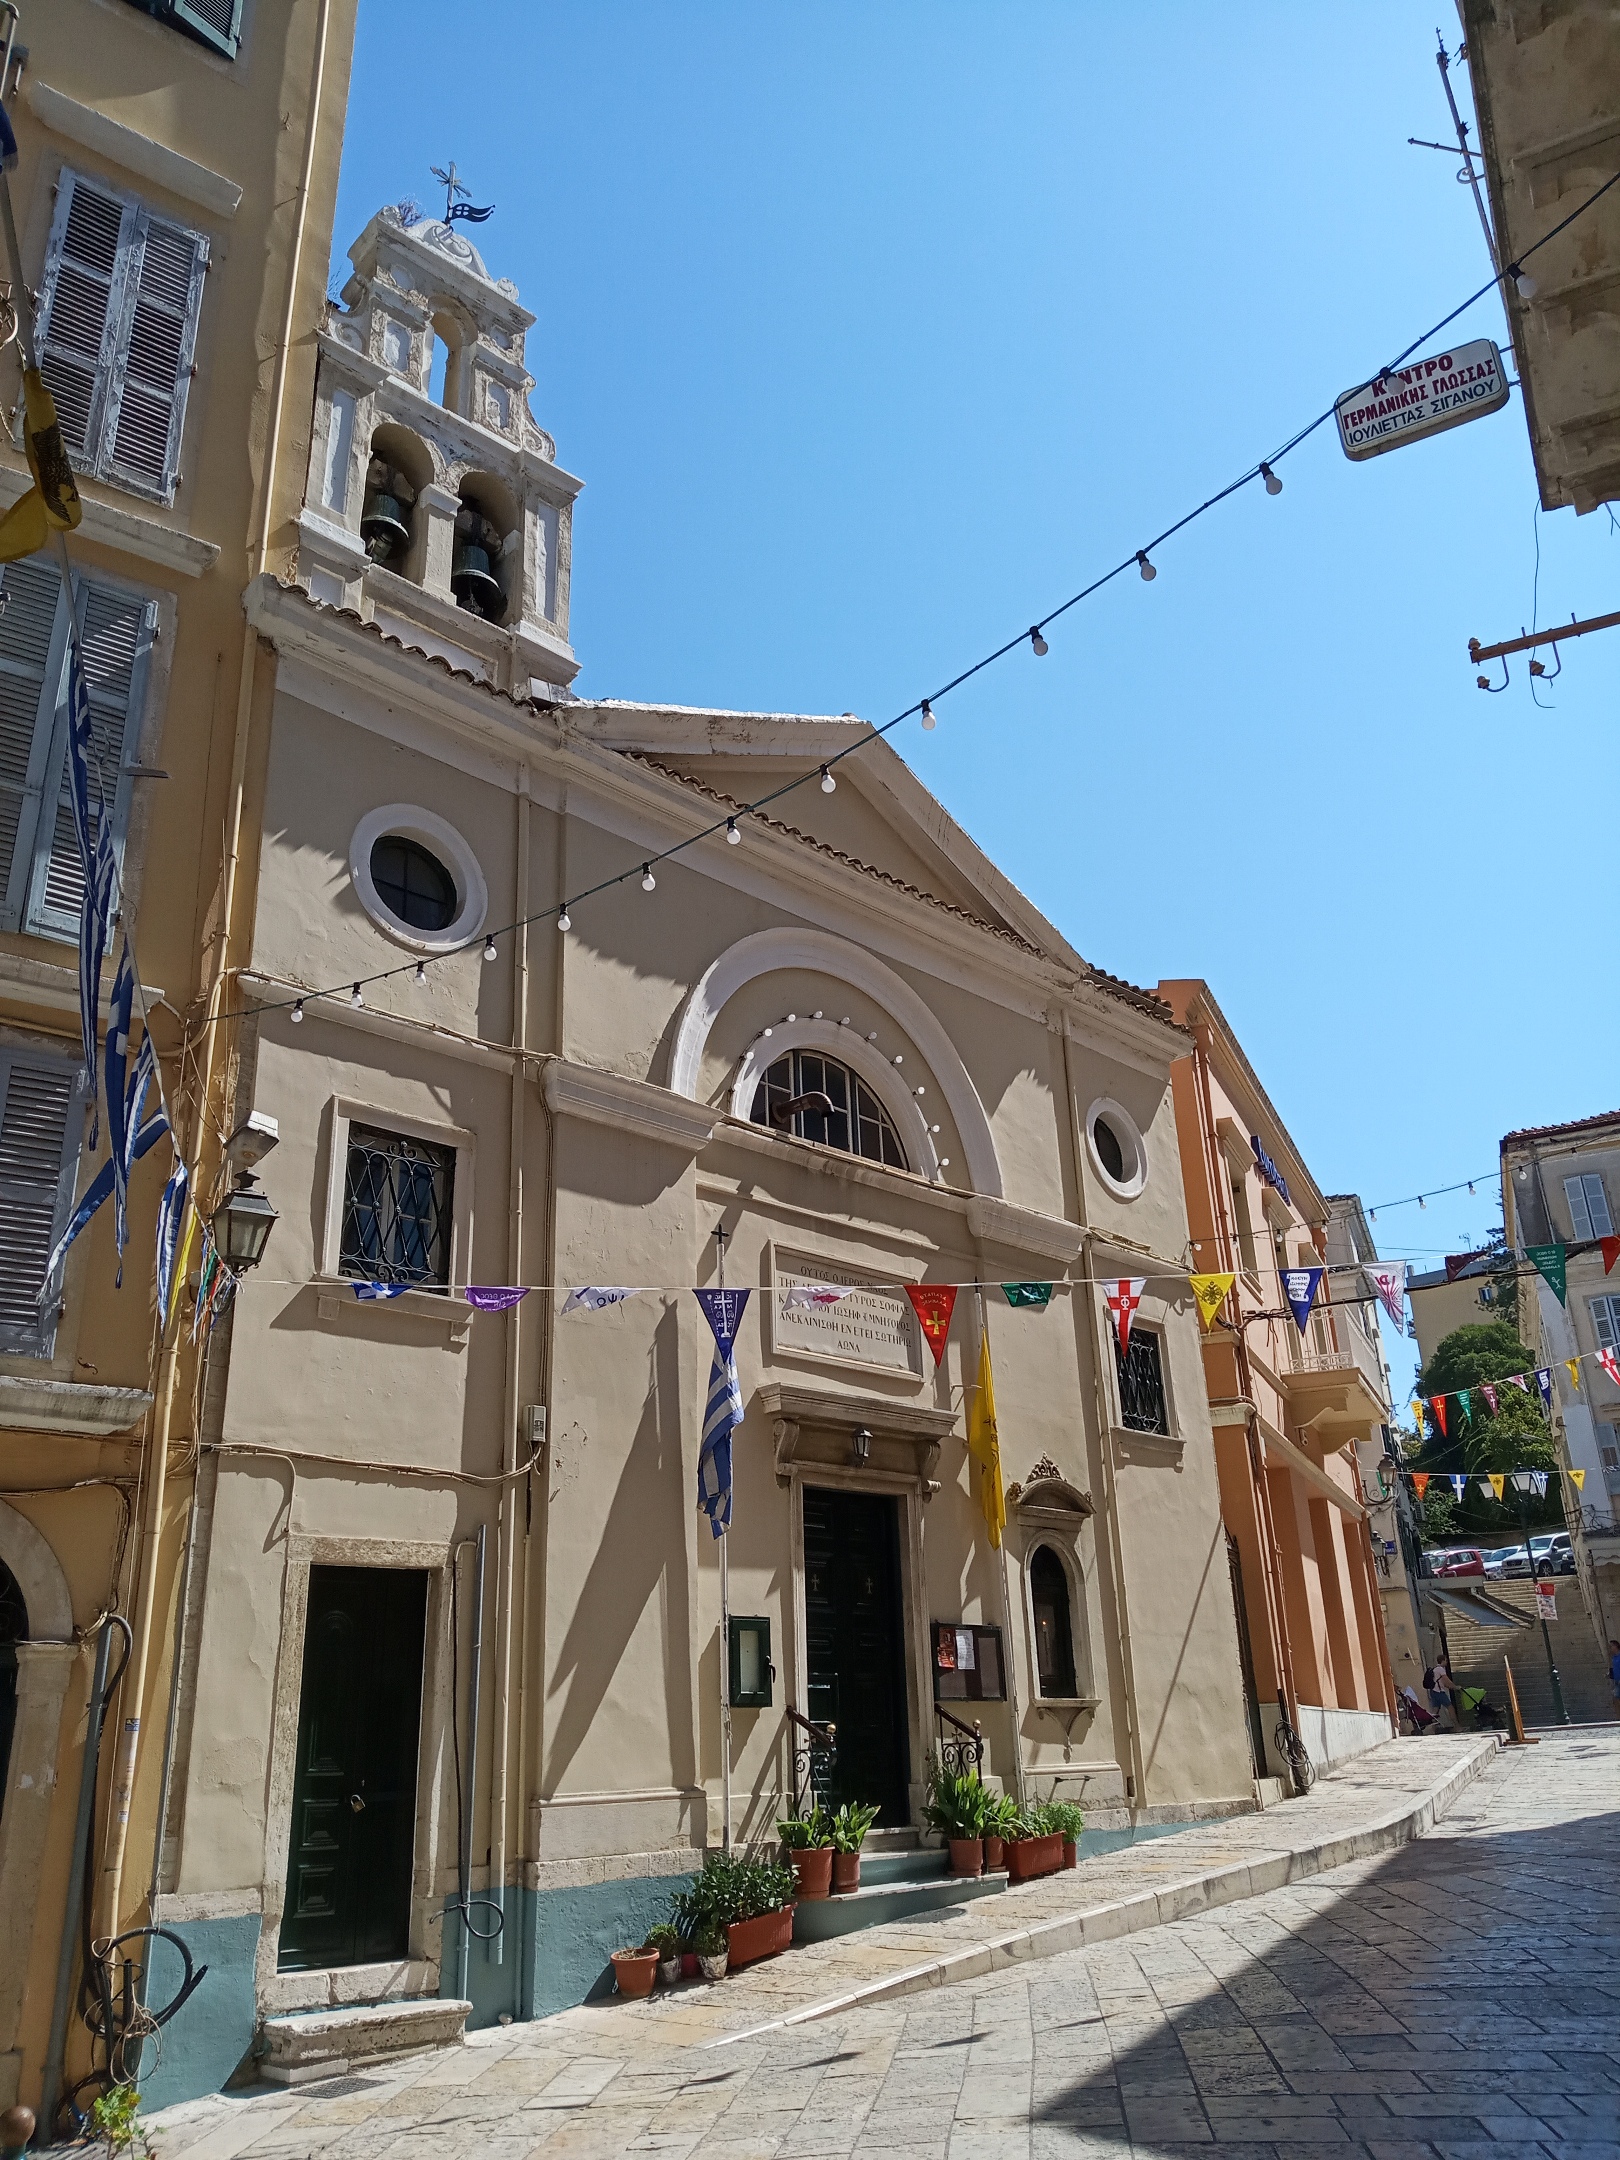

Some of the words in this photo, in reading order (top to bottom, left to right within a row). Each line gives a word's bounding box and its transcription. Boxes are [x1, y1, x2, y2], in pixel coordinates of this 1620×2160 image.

[1343, 384, 1429, 430] ΓΕΡΜΑΝΙΚΗΣ
[1432, 359, 1496, 395] ΓΛΩΣΣΑΣ
[1371, 354, 1453, 398] ΚΝΤΡΟ
[1349, 405, 1426, 445] ΙΟΥΛΙΕΤΤΑΣ
[1430, 379, 1494, 414] ΣΙΓΑΝΟΥ
[801, 1266, 830, 1281] ΟΥΤΟΣ
